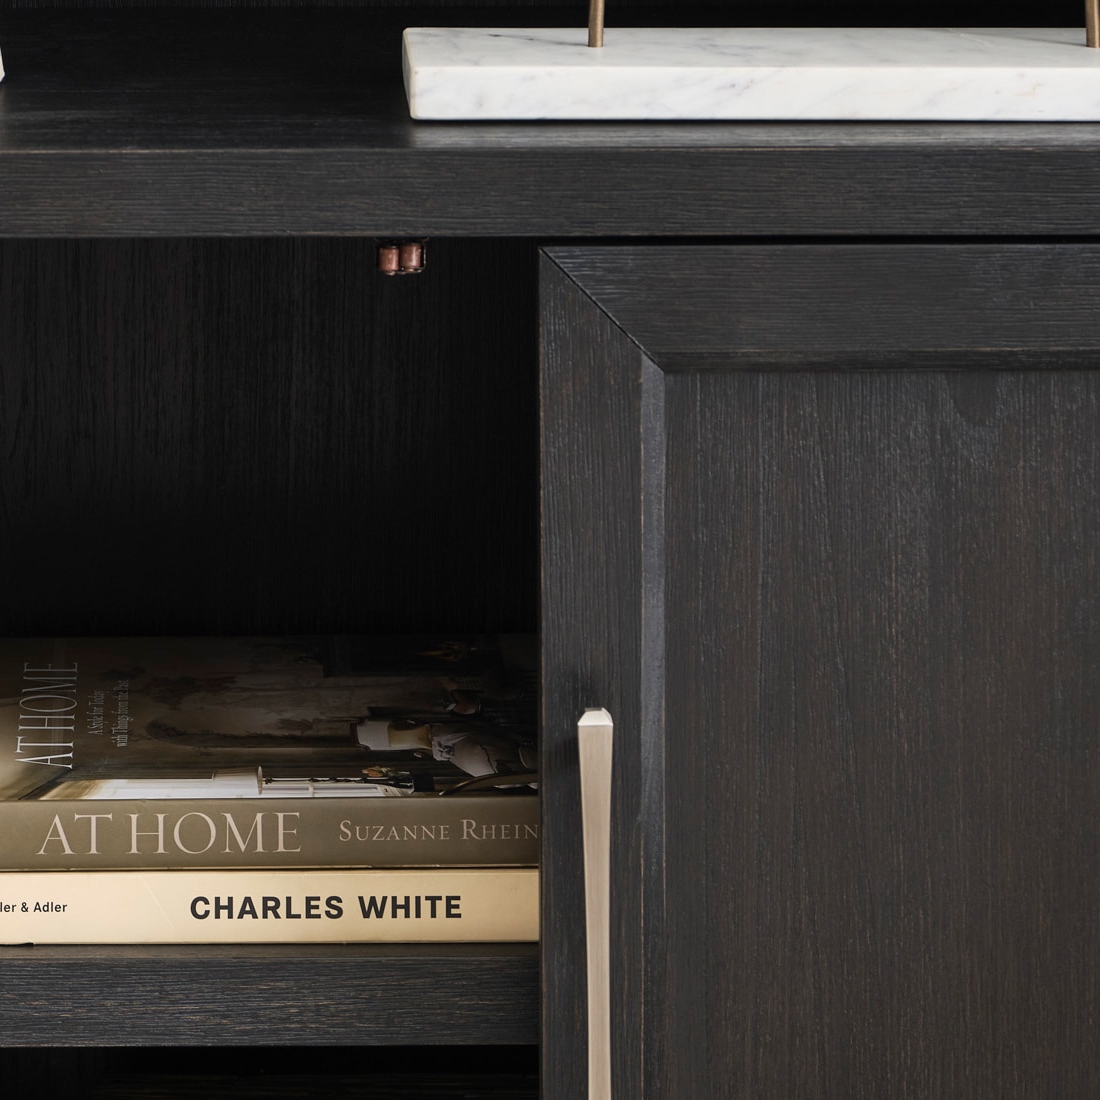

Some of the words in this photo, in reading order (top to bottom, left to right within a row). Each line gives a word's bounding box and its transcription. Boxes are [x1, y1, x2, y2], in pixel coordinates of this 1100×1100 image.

[19, 662, 78, 730] HOME
[111, 714, 134, 733] Things
[15, 736, 74, 769] AT
[110, 735, 128, 748] with
[36, 813, 113, 855] AT
[125, 812, 301, 854] HOME
[339, 820, 449, 841] SUZANNE
[20, 901, 29, 913] &
[33, 901, 68, 913] Adler
[190, 896, 344, 920] CHARLES
[358, 896, 462, 918] WHITE
